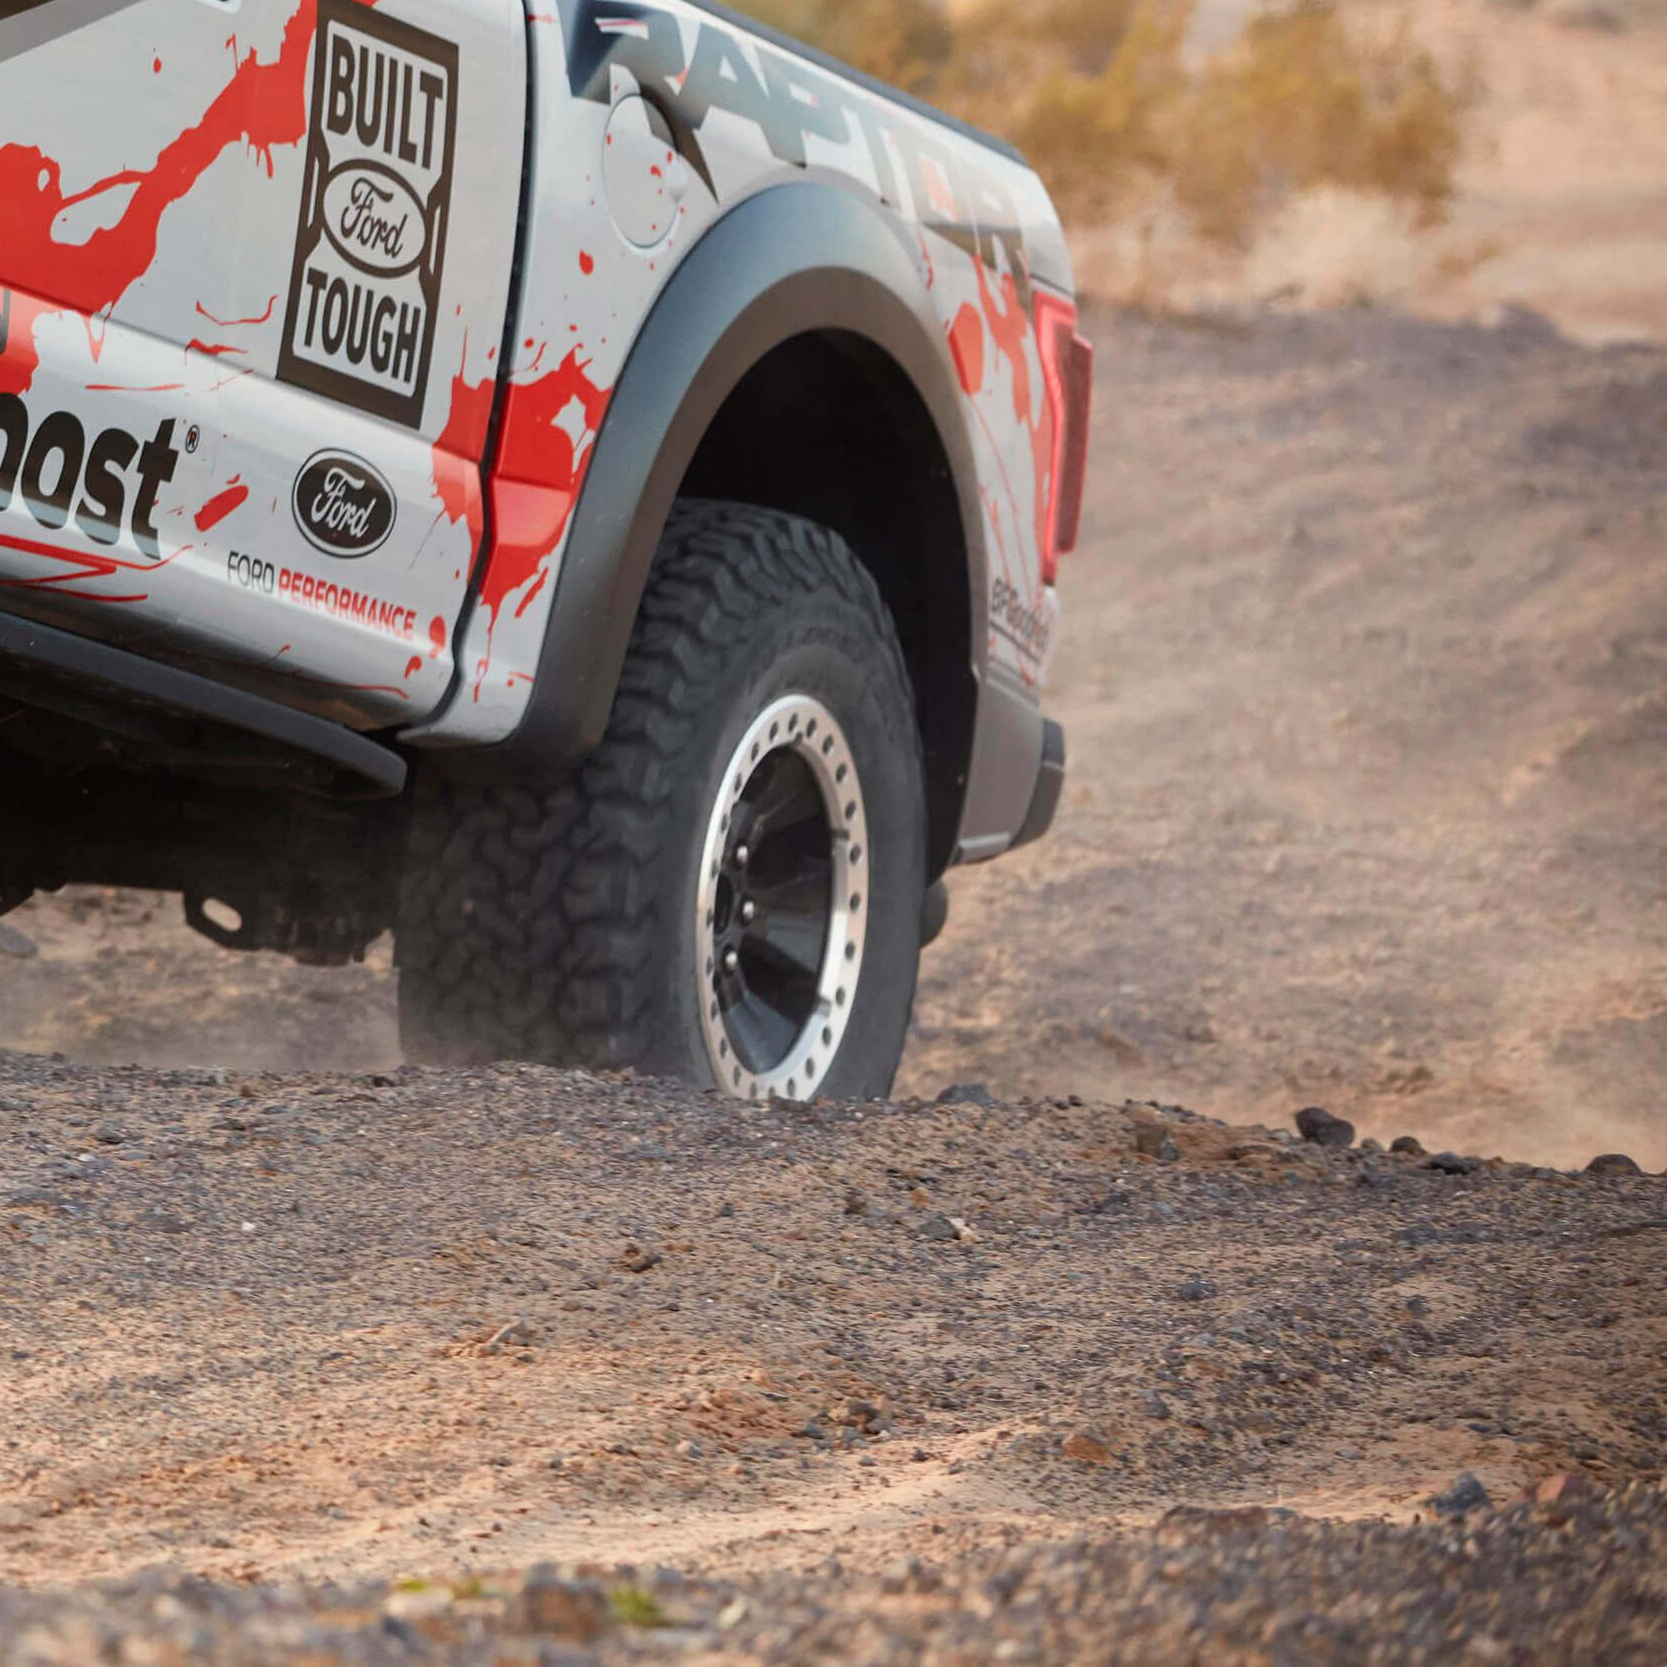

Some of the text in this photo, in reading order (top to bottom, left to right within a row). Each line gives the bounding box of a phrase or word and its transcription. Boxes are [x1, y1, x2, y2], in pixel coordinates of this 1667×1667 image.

[327, 34, 445, 171] BUILT
[340, 177, 406, 260] Ford
[303, 270, 422, 385] TOUGH
[311, 467, 371, 540] Ford
[227, 549, 417, 640] FORD PERFORMANCE
